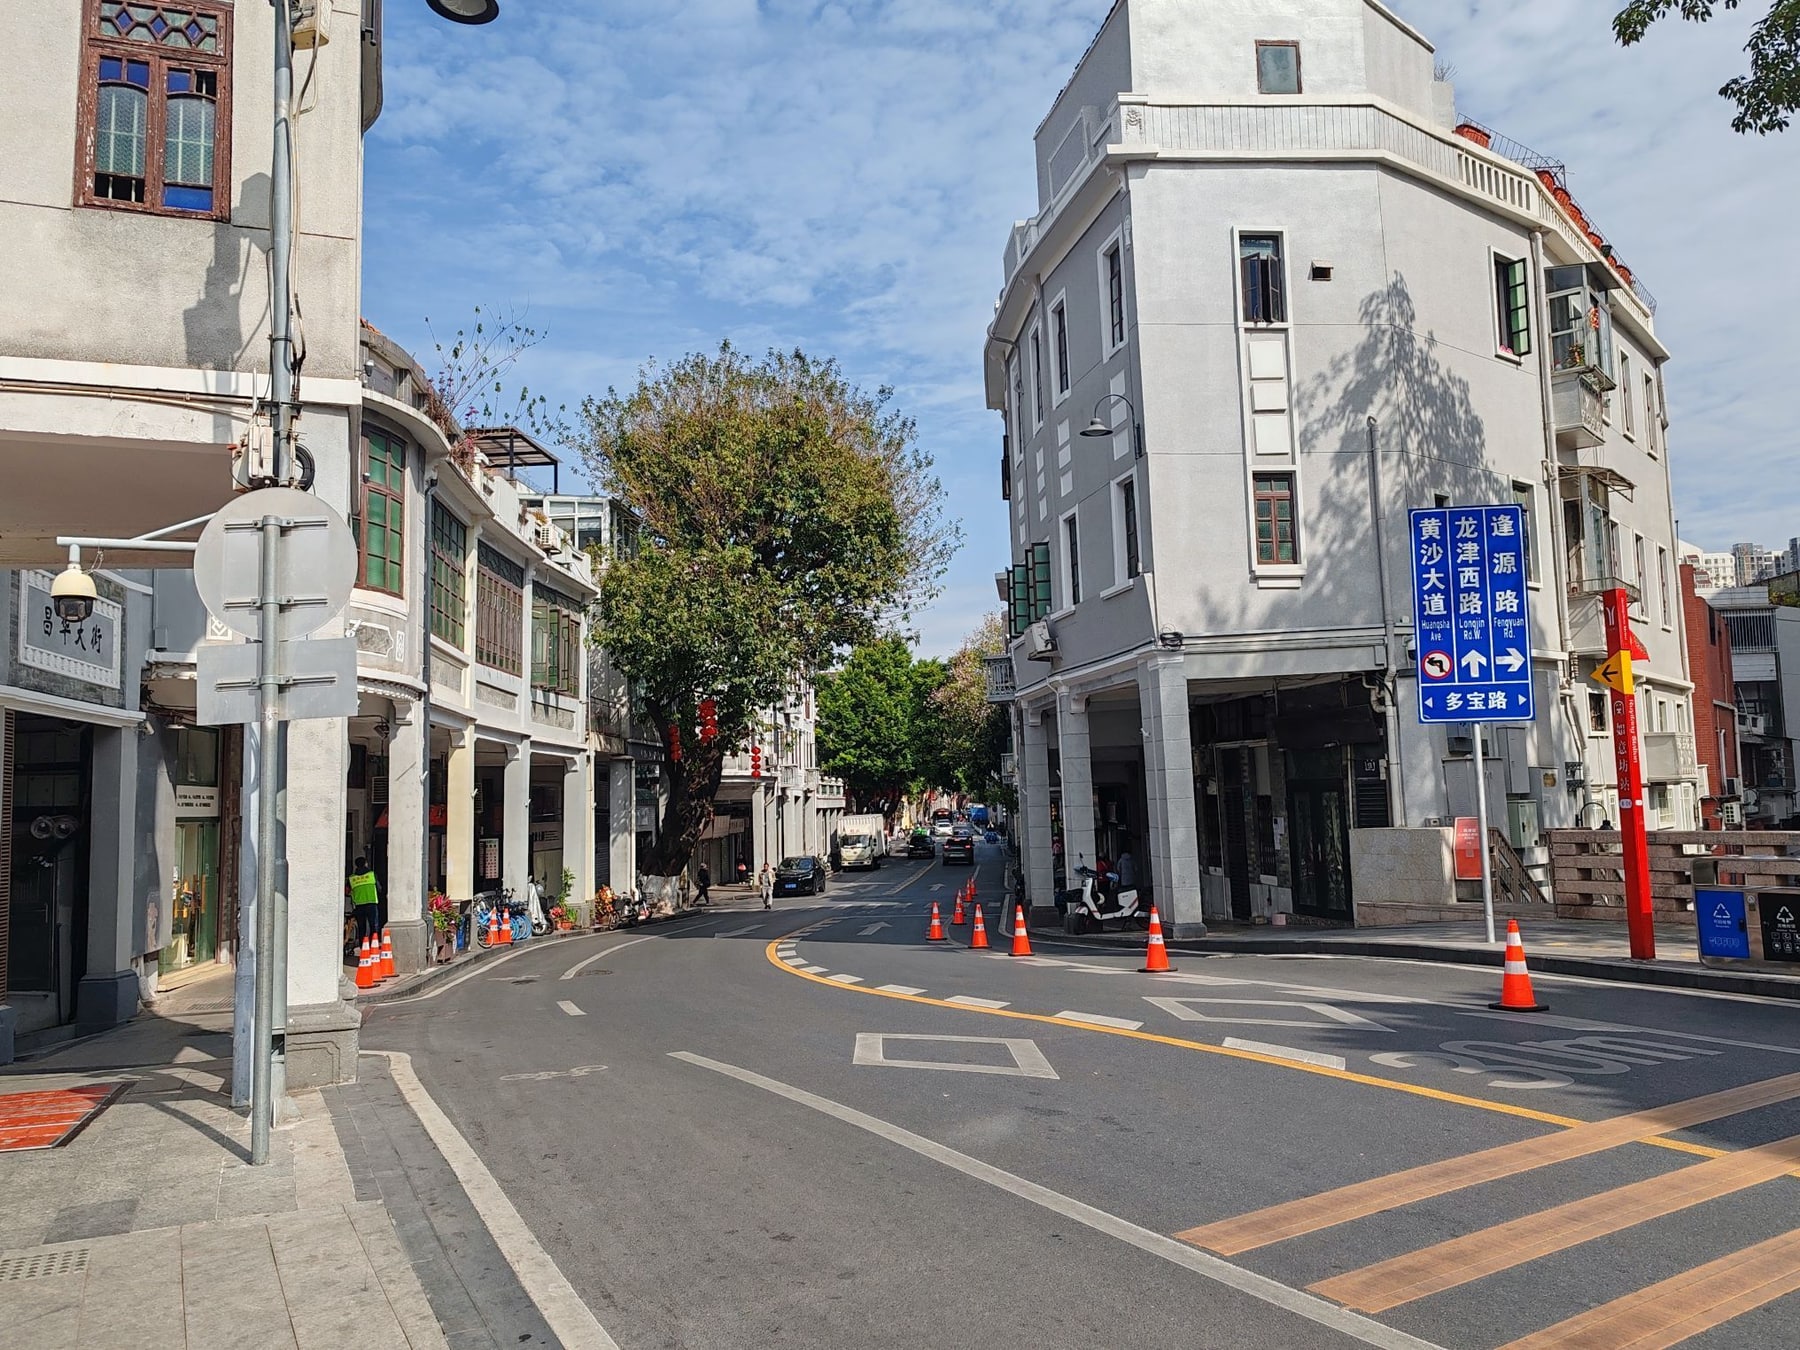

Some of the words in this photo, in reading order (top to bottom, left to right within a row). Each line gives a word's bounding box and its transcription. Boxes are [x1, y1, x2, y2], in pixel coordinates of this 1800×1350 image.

[1419, 517, 1447, 616] 黄沙大道
[1454, 516, 1483, 615] 龙津西路
[1491, 514, 1519, 614] 逢源路
[43, 606, 102, 654] 昌华大街
[1421, 619, 1450, 631] Huangsha
[1459, 617, 1485, 630] Longjin
[1493, 616, 1525, 630] Fengyuan
[1430, 631, 1444, 641] Ave.
[1503, 628, 1516, 639] Rd.
[1446, 691, 1508, 711] 多宝路
[1368, 1036, 1725, 1089] 30m
